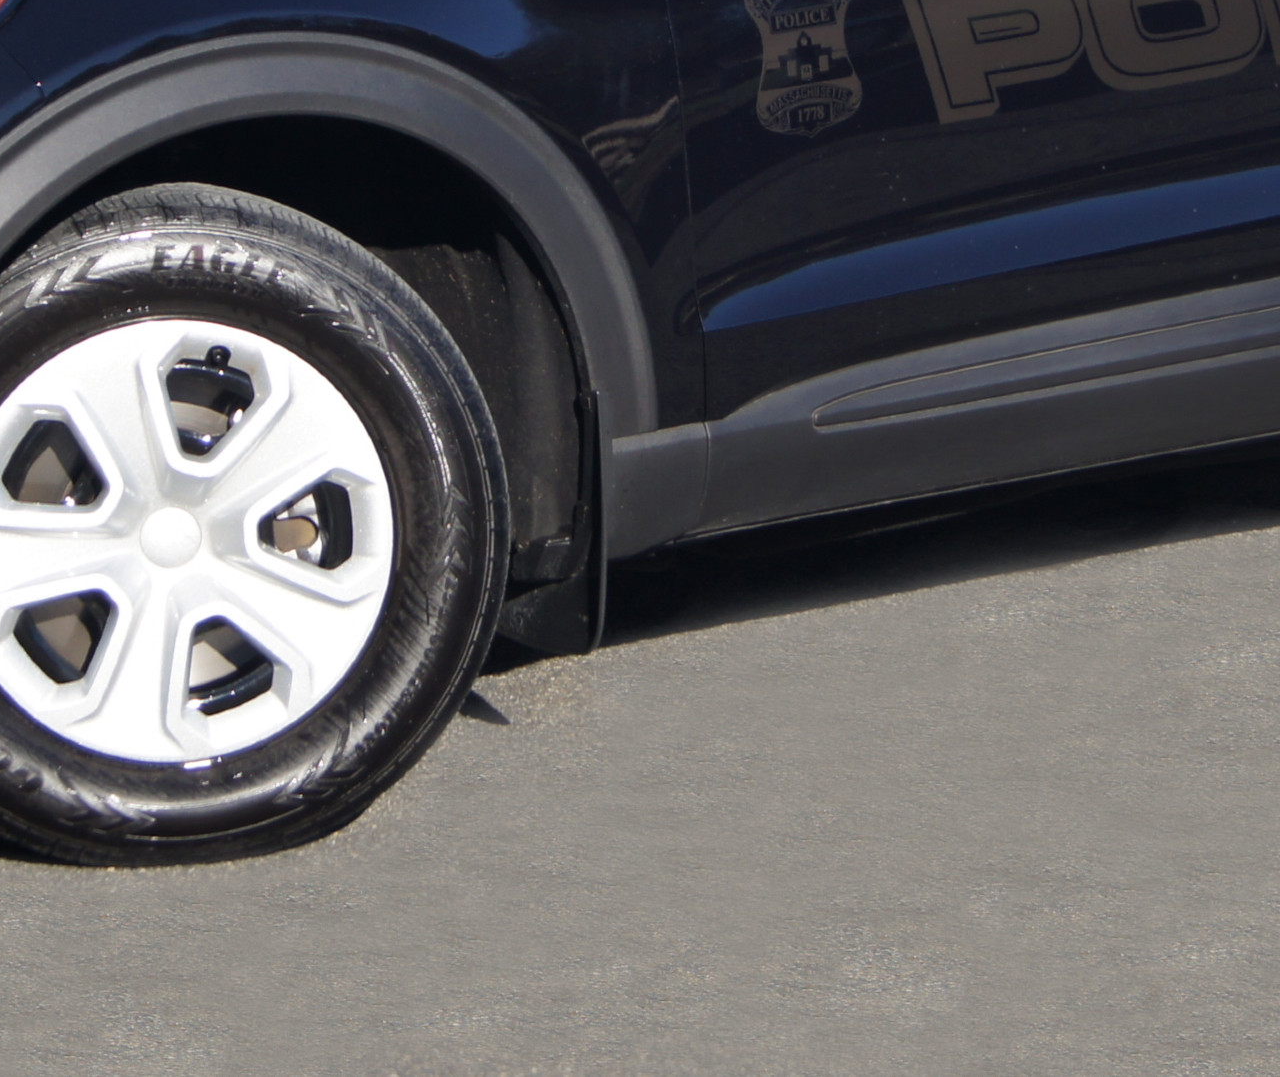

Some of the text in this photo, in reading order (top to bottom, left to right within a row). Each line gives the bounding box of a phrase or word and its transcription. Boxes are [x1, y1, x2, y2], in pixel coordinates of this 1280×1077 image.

[775, 8, 830, 29] POLICE
[770, 85, 849, 113] MASSACHUSETTS
[798, 106, 825, 122] 1778
